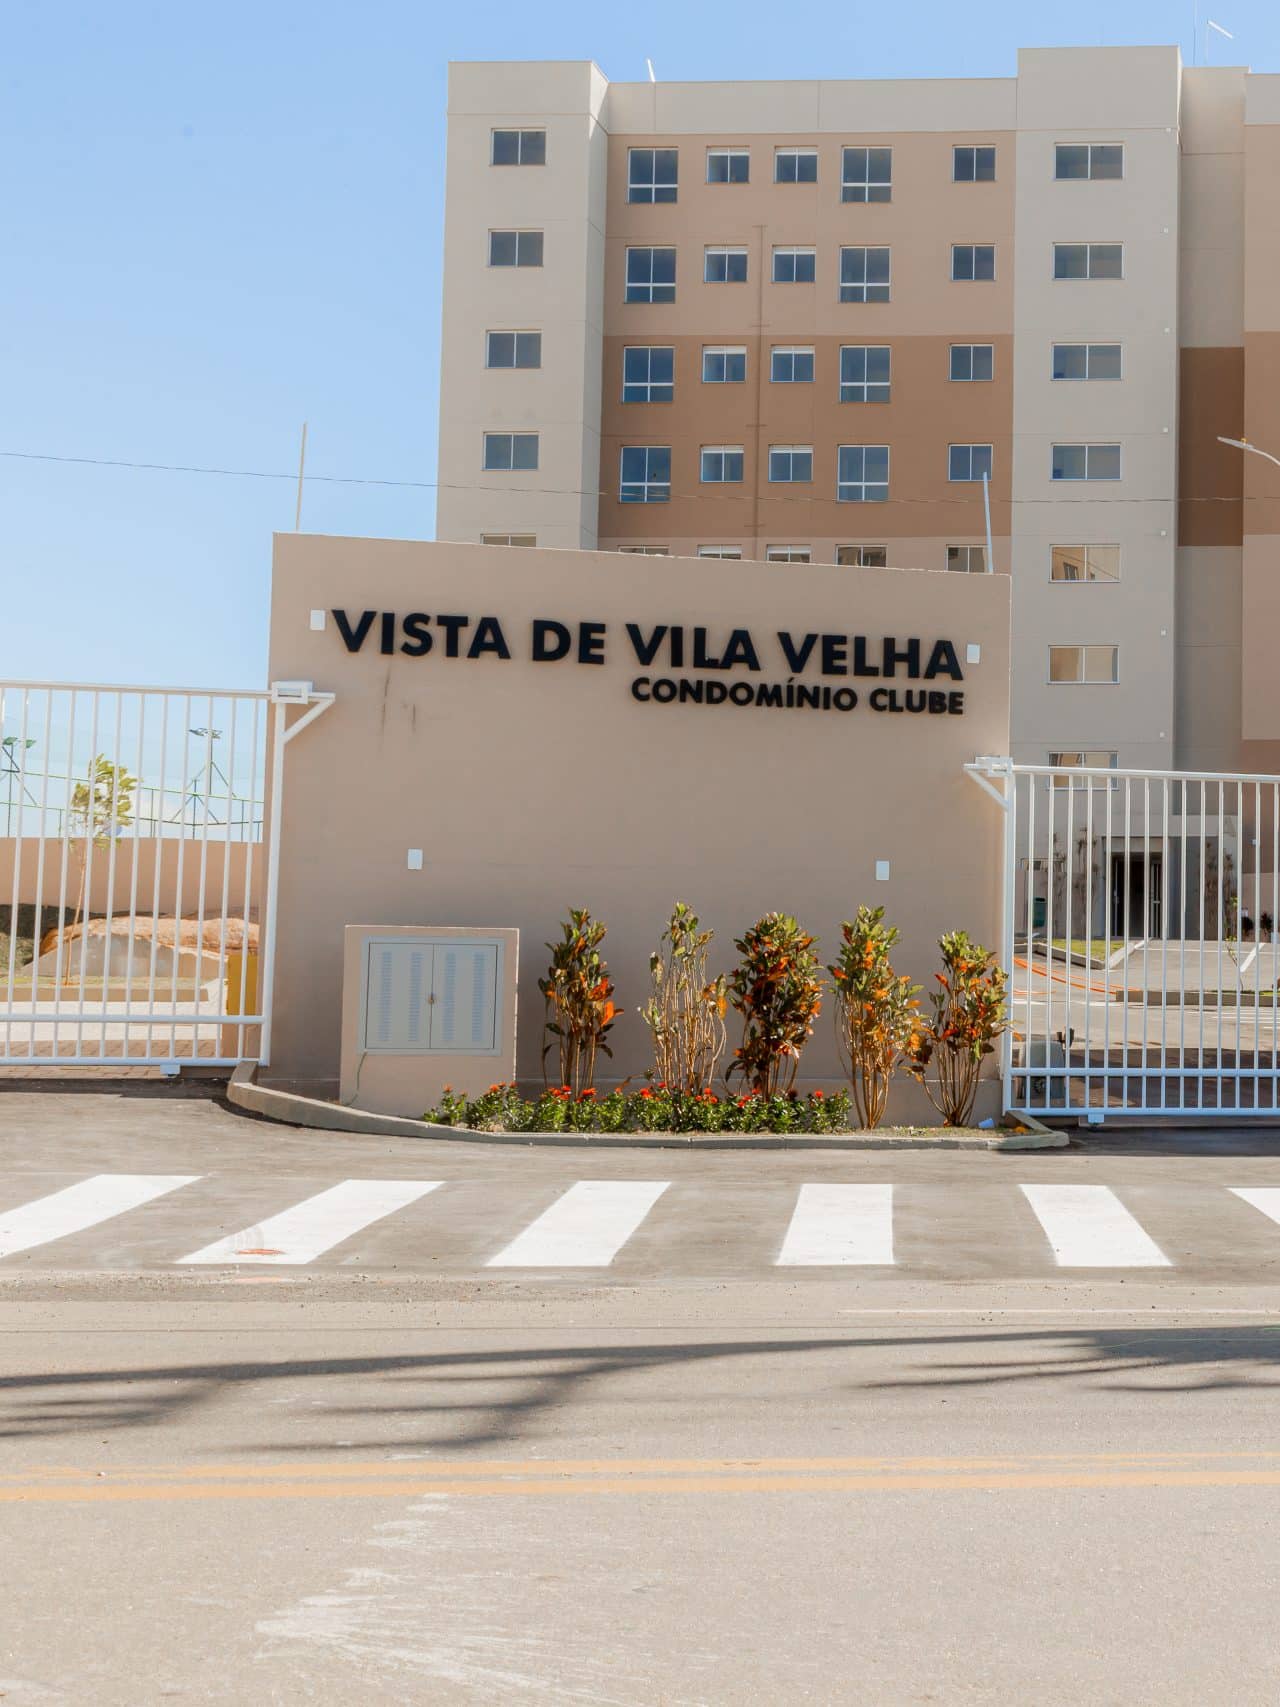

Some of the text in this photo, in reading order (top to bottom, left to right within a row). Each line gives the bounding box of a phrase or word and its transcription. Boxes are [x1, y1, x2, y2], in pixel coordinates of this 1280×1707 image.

[331, 609, 964, 681] VISTA DE VILA VELHA
[631, 677, 964, 715] CONDOMÍNIO CLUBE
